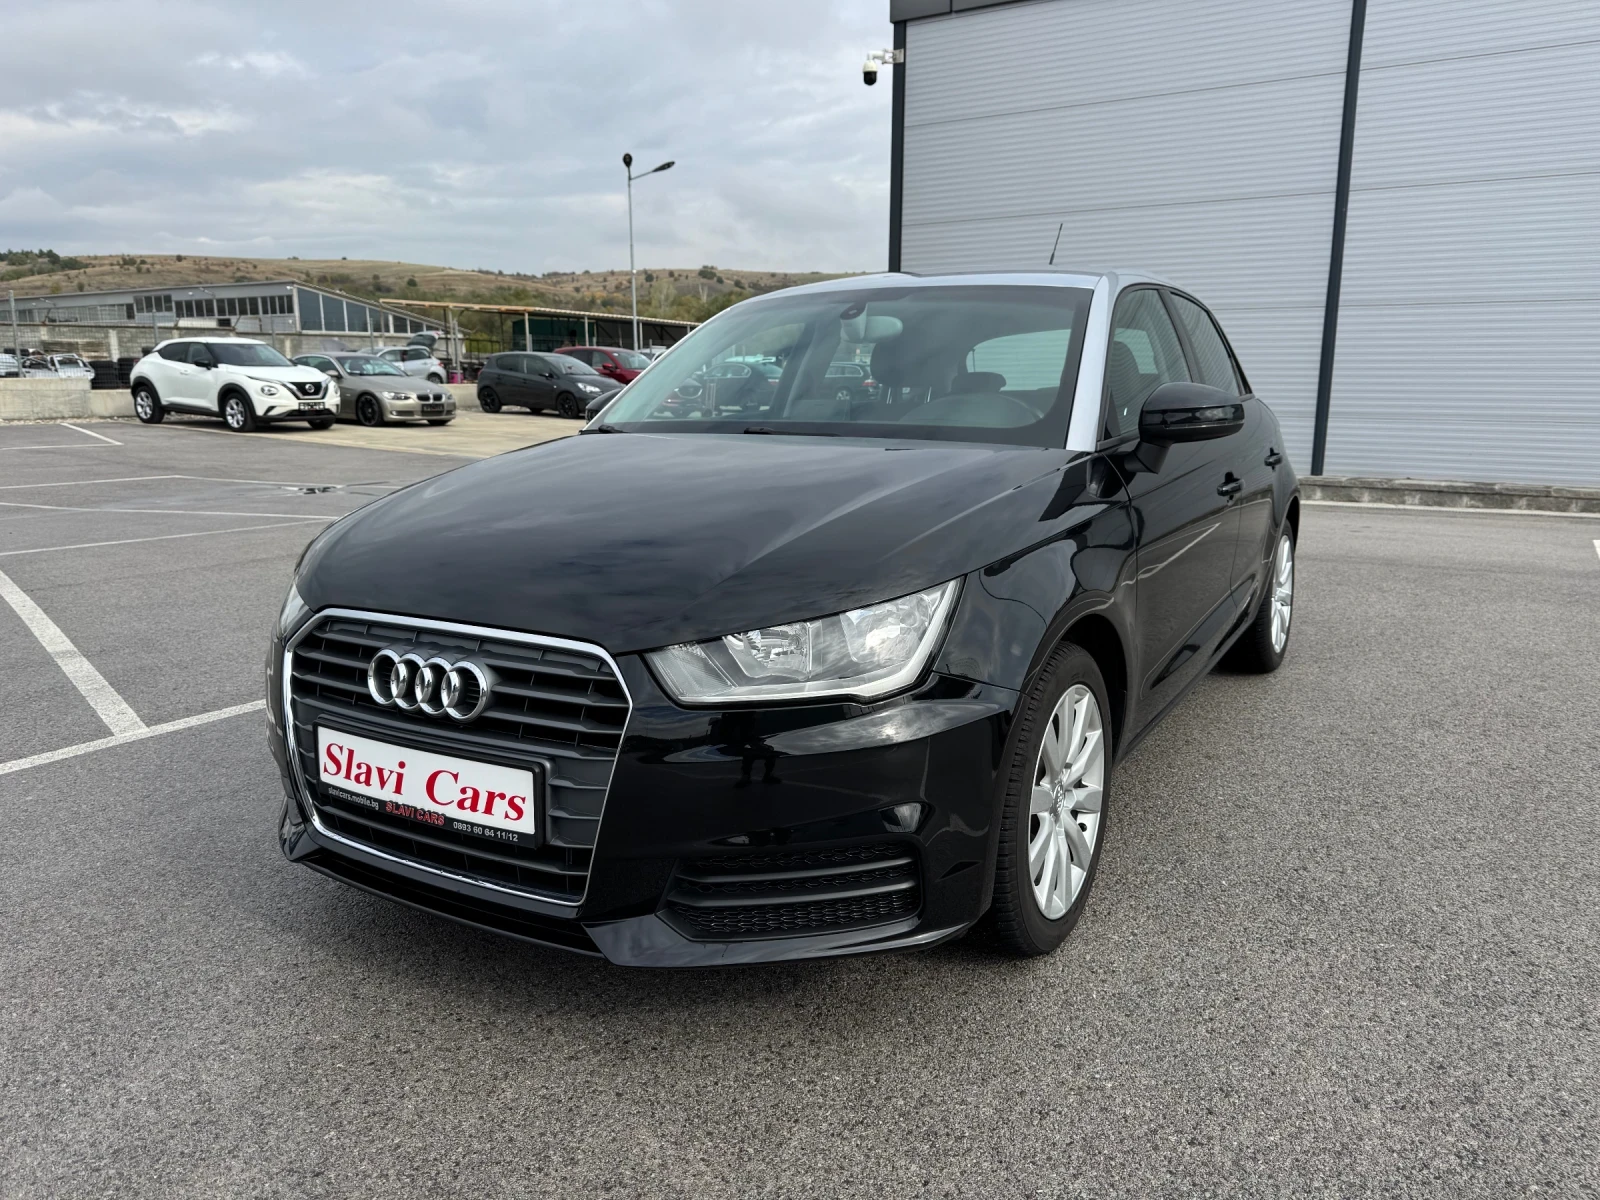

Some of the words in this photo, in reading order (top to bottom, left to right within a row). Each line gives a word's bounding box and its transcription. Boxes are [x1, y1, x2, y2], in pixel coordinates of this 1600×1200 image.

[323, 743, 406, 795] Slavi
[425, 769, 526, 821] Cars
[328, 787, 379, 811] slavicars.mobile.bg
[385, 801, 414, 818] SLAVI
[416, 808, 445, 826] CARS
[453, 821, 471, 832] 0893
[473, 826, 483, 834] 60
[484, 829, 494, 837] 64
[496, 831, 518, 841] 11/12
